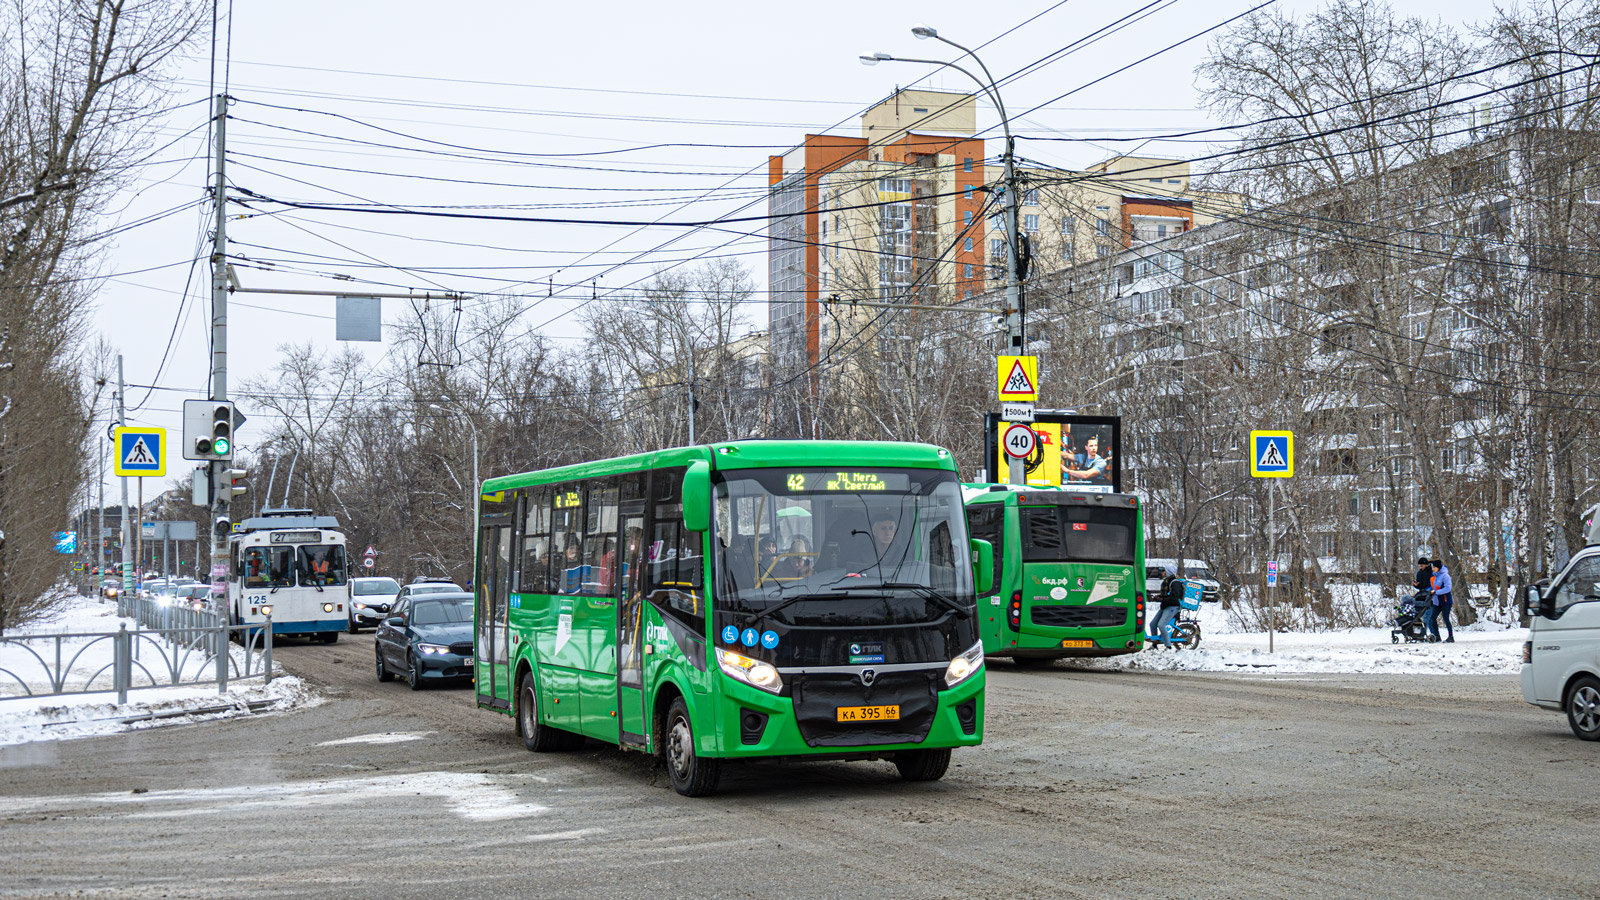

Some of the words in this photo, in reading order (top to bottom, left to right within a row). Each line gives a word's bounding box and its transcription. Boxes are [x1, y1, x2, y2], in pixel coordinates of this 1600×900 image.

[1009, 408, 1027, 416] 500м
[1011, 435, 1028, 449] 40
[787, 474, 805, 490] 42
[836, 472, 849, 482] ТЦ
[853, 473, 877, 481] Мега
[827, 481, 840, 490] ЖК
[844, 481, 885, 490] Светлый
[274, 533, 286, 542] 27
[1042, 576, 1068, 586] бкд.рф
[247, 595, 267, 605] 125
[653, 625, 669, 641] ГТЛК
[842, 711, 856, 720] КА
[860, 707, 880, 719] 395
[886, 707, 896, 715] 66
